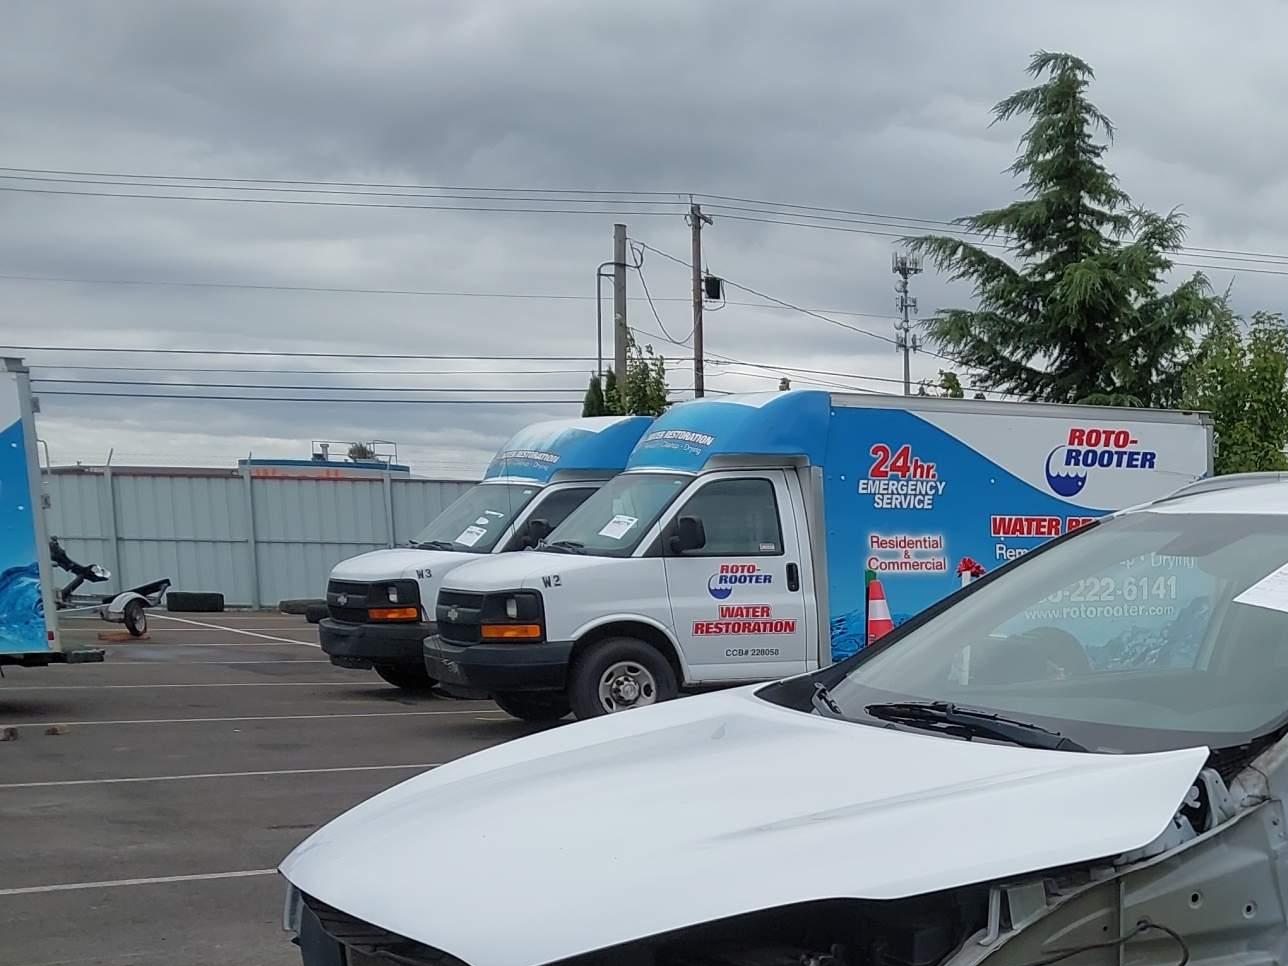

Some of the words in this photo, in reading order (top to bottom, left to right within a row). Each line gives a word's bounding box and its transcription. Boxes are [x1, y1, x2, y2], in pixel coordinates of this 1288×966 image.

[1068, 429, 1138, 449] ROTO-
[1065, 449, 1157, 469] ROOTER
[858, 480, 946, 496] EMERGENCY
[873, 494, 933, 509] SERVICE
[991, 516, 1062, 536] WATER
[869, 535, 943, 549] Residential
[903, 549, 911, 559] &
[720, 564, 761, 574] ROTO-
[867, 557, 947, 571] Commercial
[718, 574, 773, 585] ROOTER
[719, 606, 771, 618] WATER
[1023, 602, 1175, 620] www.rotorooter.com
[693, 621, 796, 635] RESTORATION
